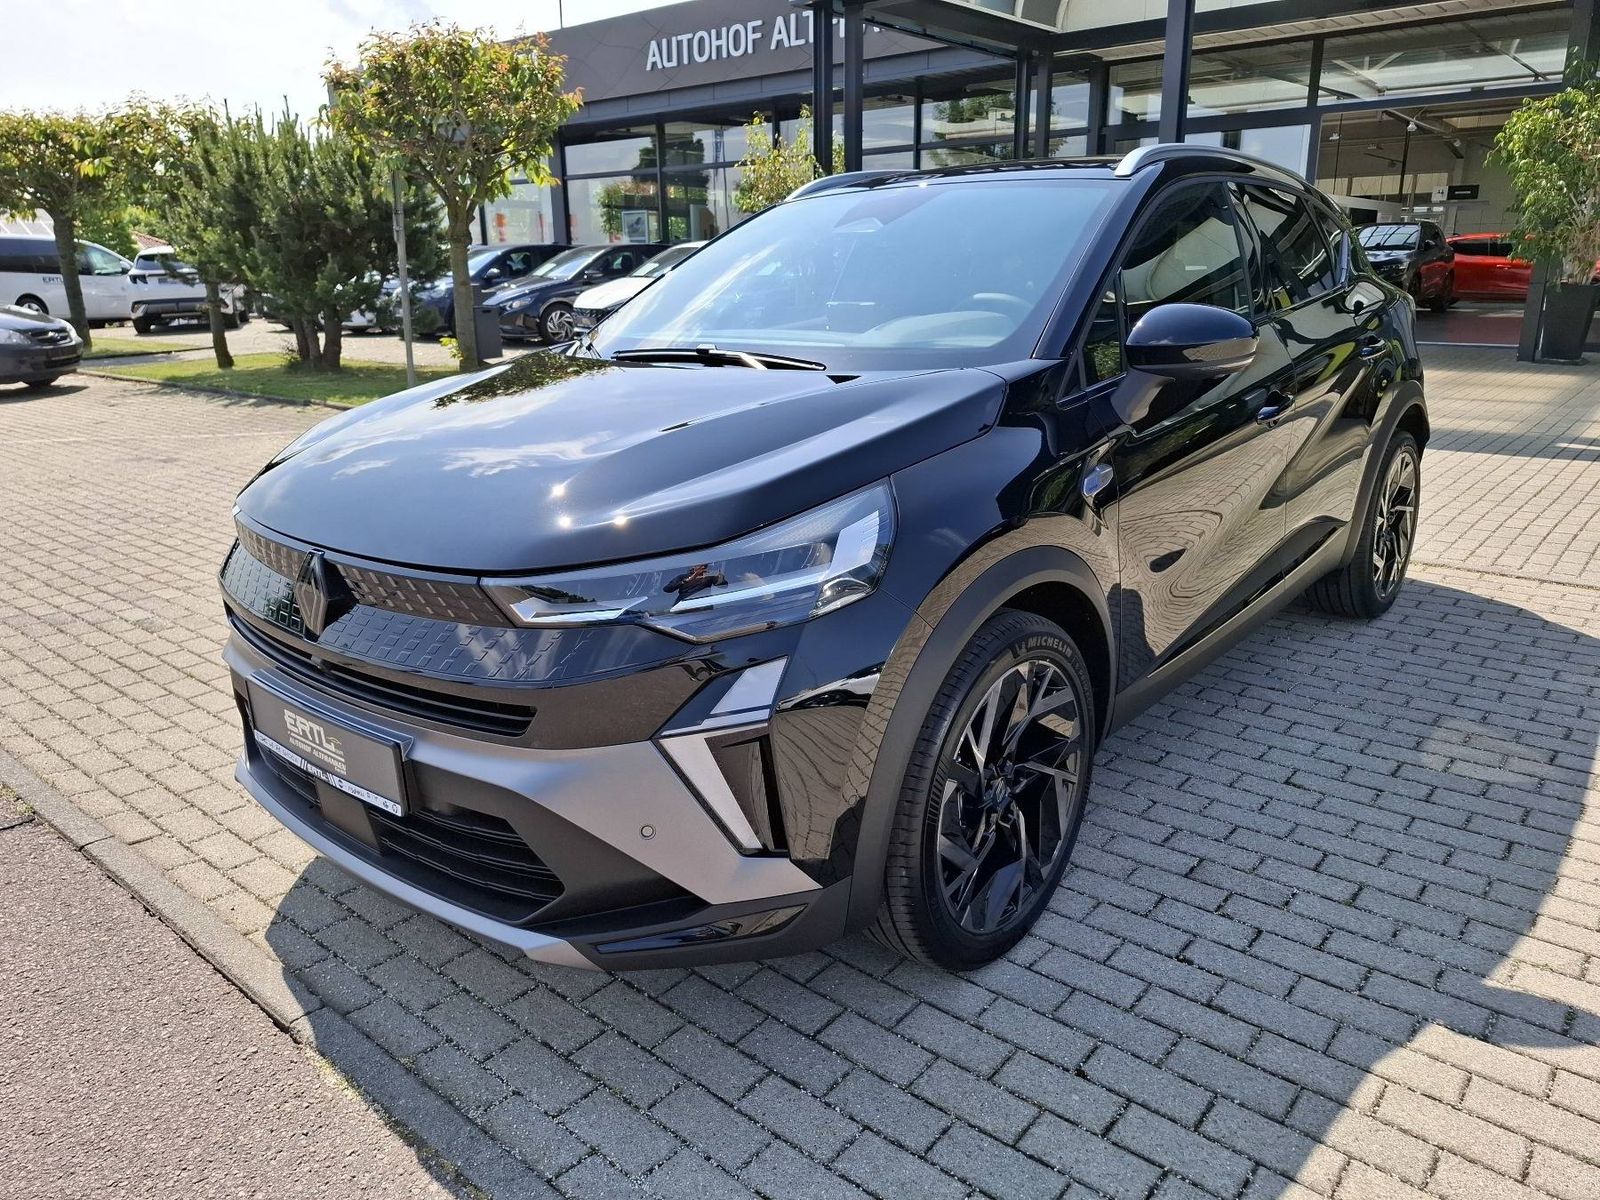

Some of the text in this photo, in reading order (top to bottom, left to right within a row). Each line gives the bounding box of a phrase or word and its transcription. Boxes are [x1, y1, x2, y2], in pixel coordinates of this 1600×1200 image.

[646, 20, 763, 71] AUTOHOF
[1027, 636, 1073, 658] MICHELIN
[284, 709, 335, 750] ERTL
